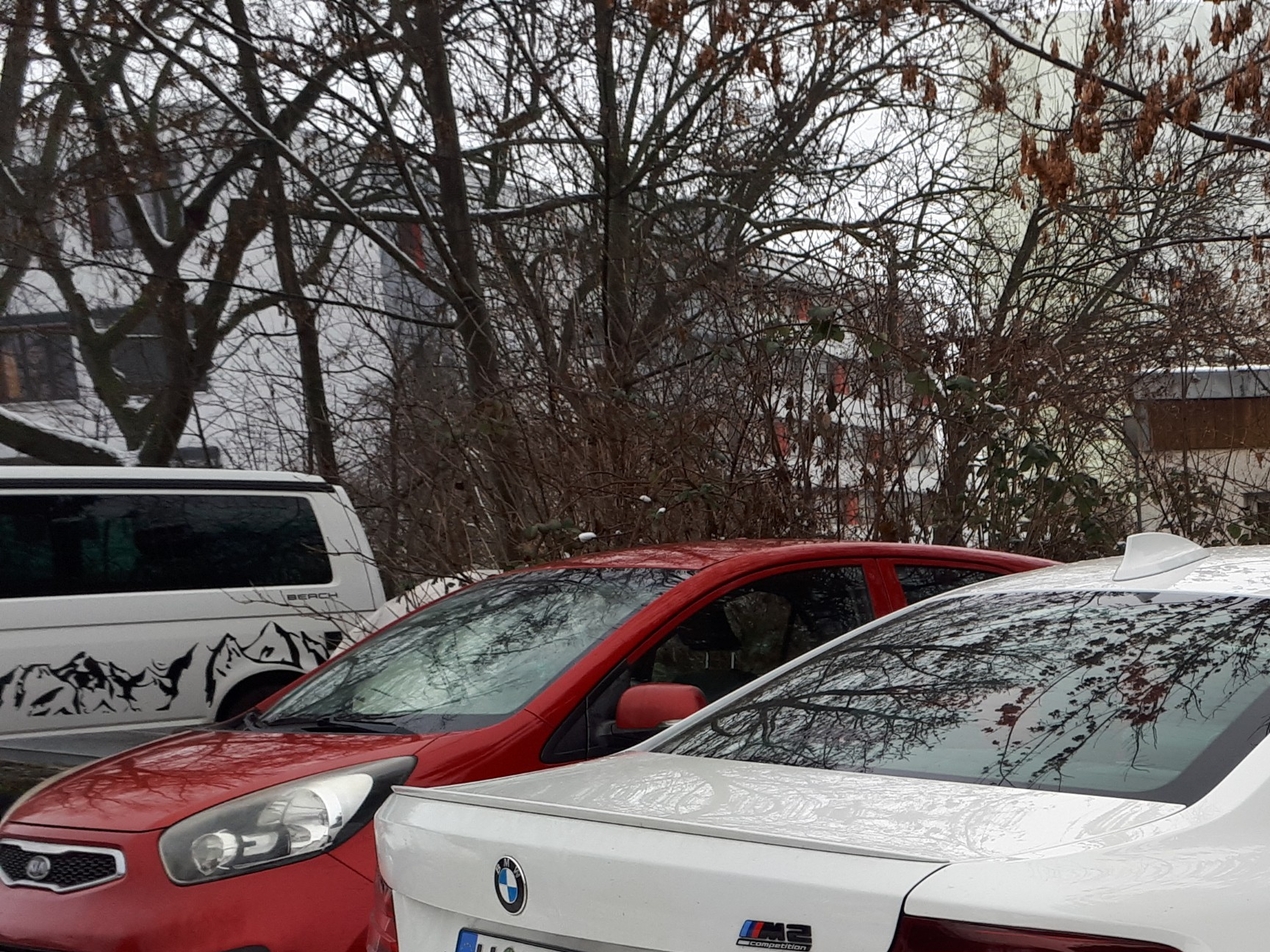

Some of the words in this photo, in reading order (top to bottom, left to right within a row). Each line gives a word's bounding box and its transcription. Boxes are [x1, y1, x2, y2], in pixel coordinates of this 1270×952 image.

[286, 592, 339, 601] BEACH
[739, 919, 812, 944] M2
[749, 941, 807, 951] competition
